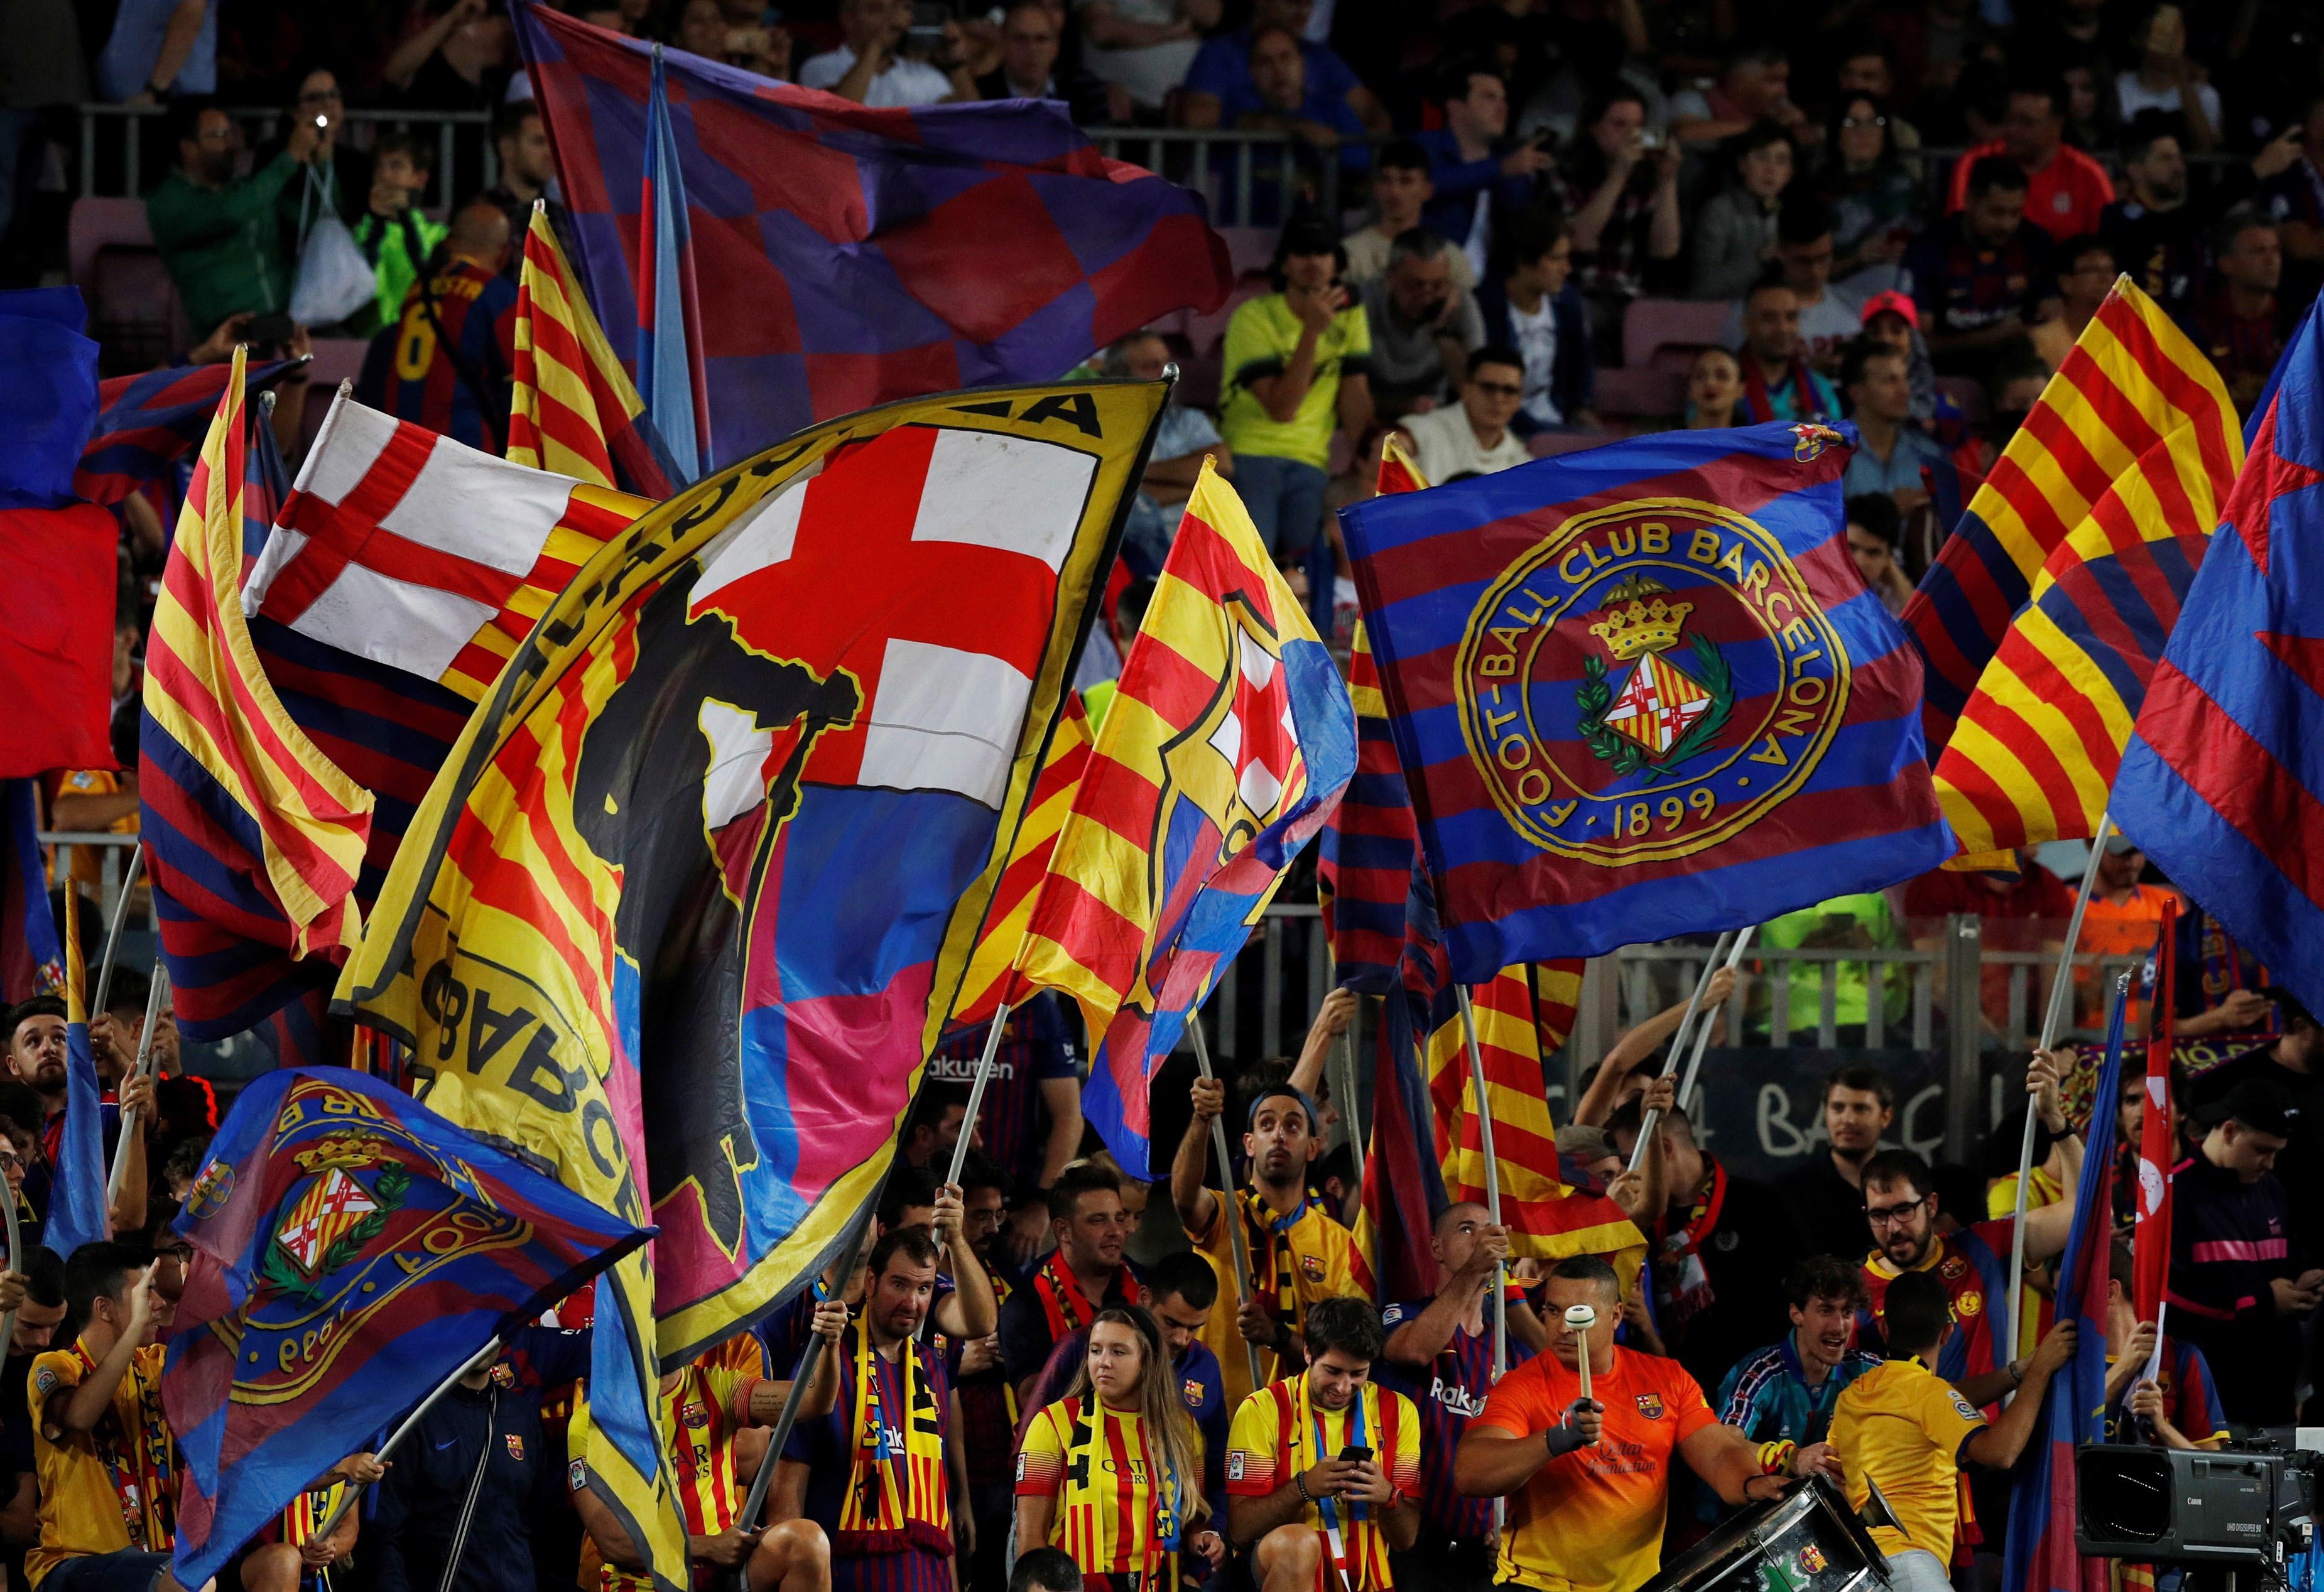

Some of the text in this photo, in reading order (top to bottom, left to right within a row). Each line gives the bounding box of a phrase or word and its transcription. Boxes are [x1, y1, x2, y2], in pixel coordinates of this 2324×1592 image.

[1480, 523, 1825, 827] FOOT-BALL CLUB BARCELONA
[1612, 788, 1715, 839] 1899
[1600, 1439, 1644, 1461] Qatar
[2187, 1497, 2202, 1505] Canon
